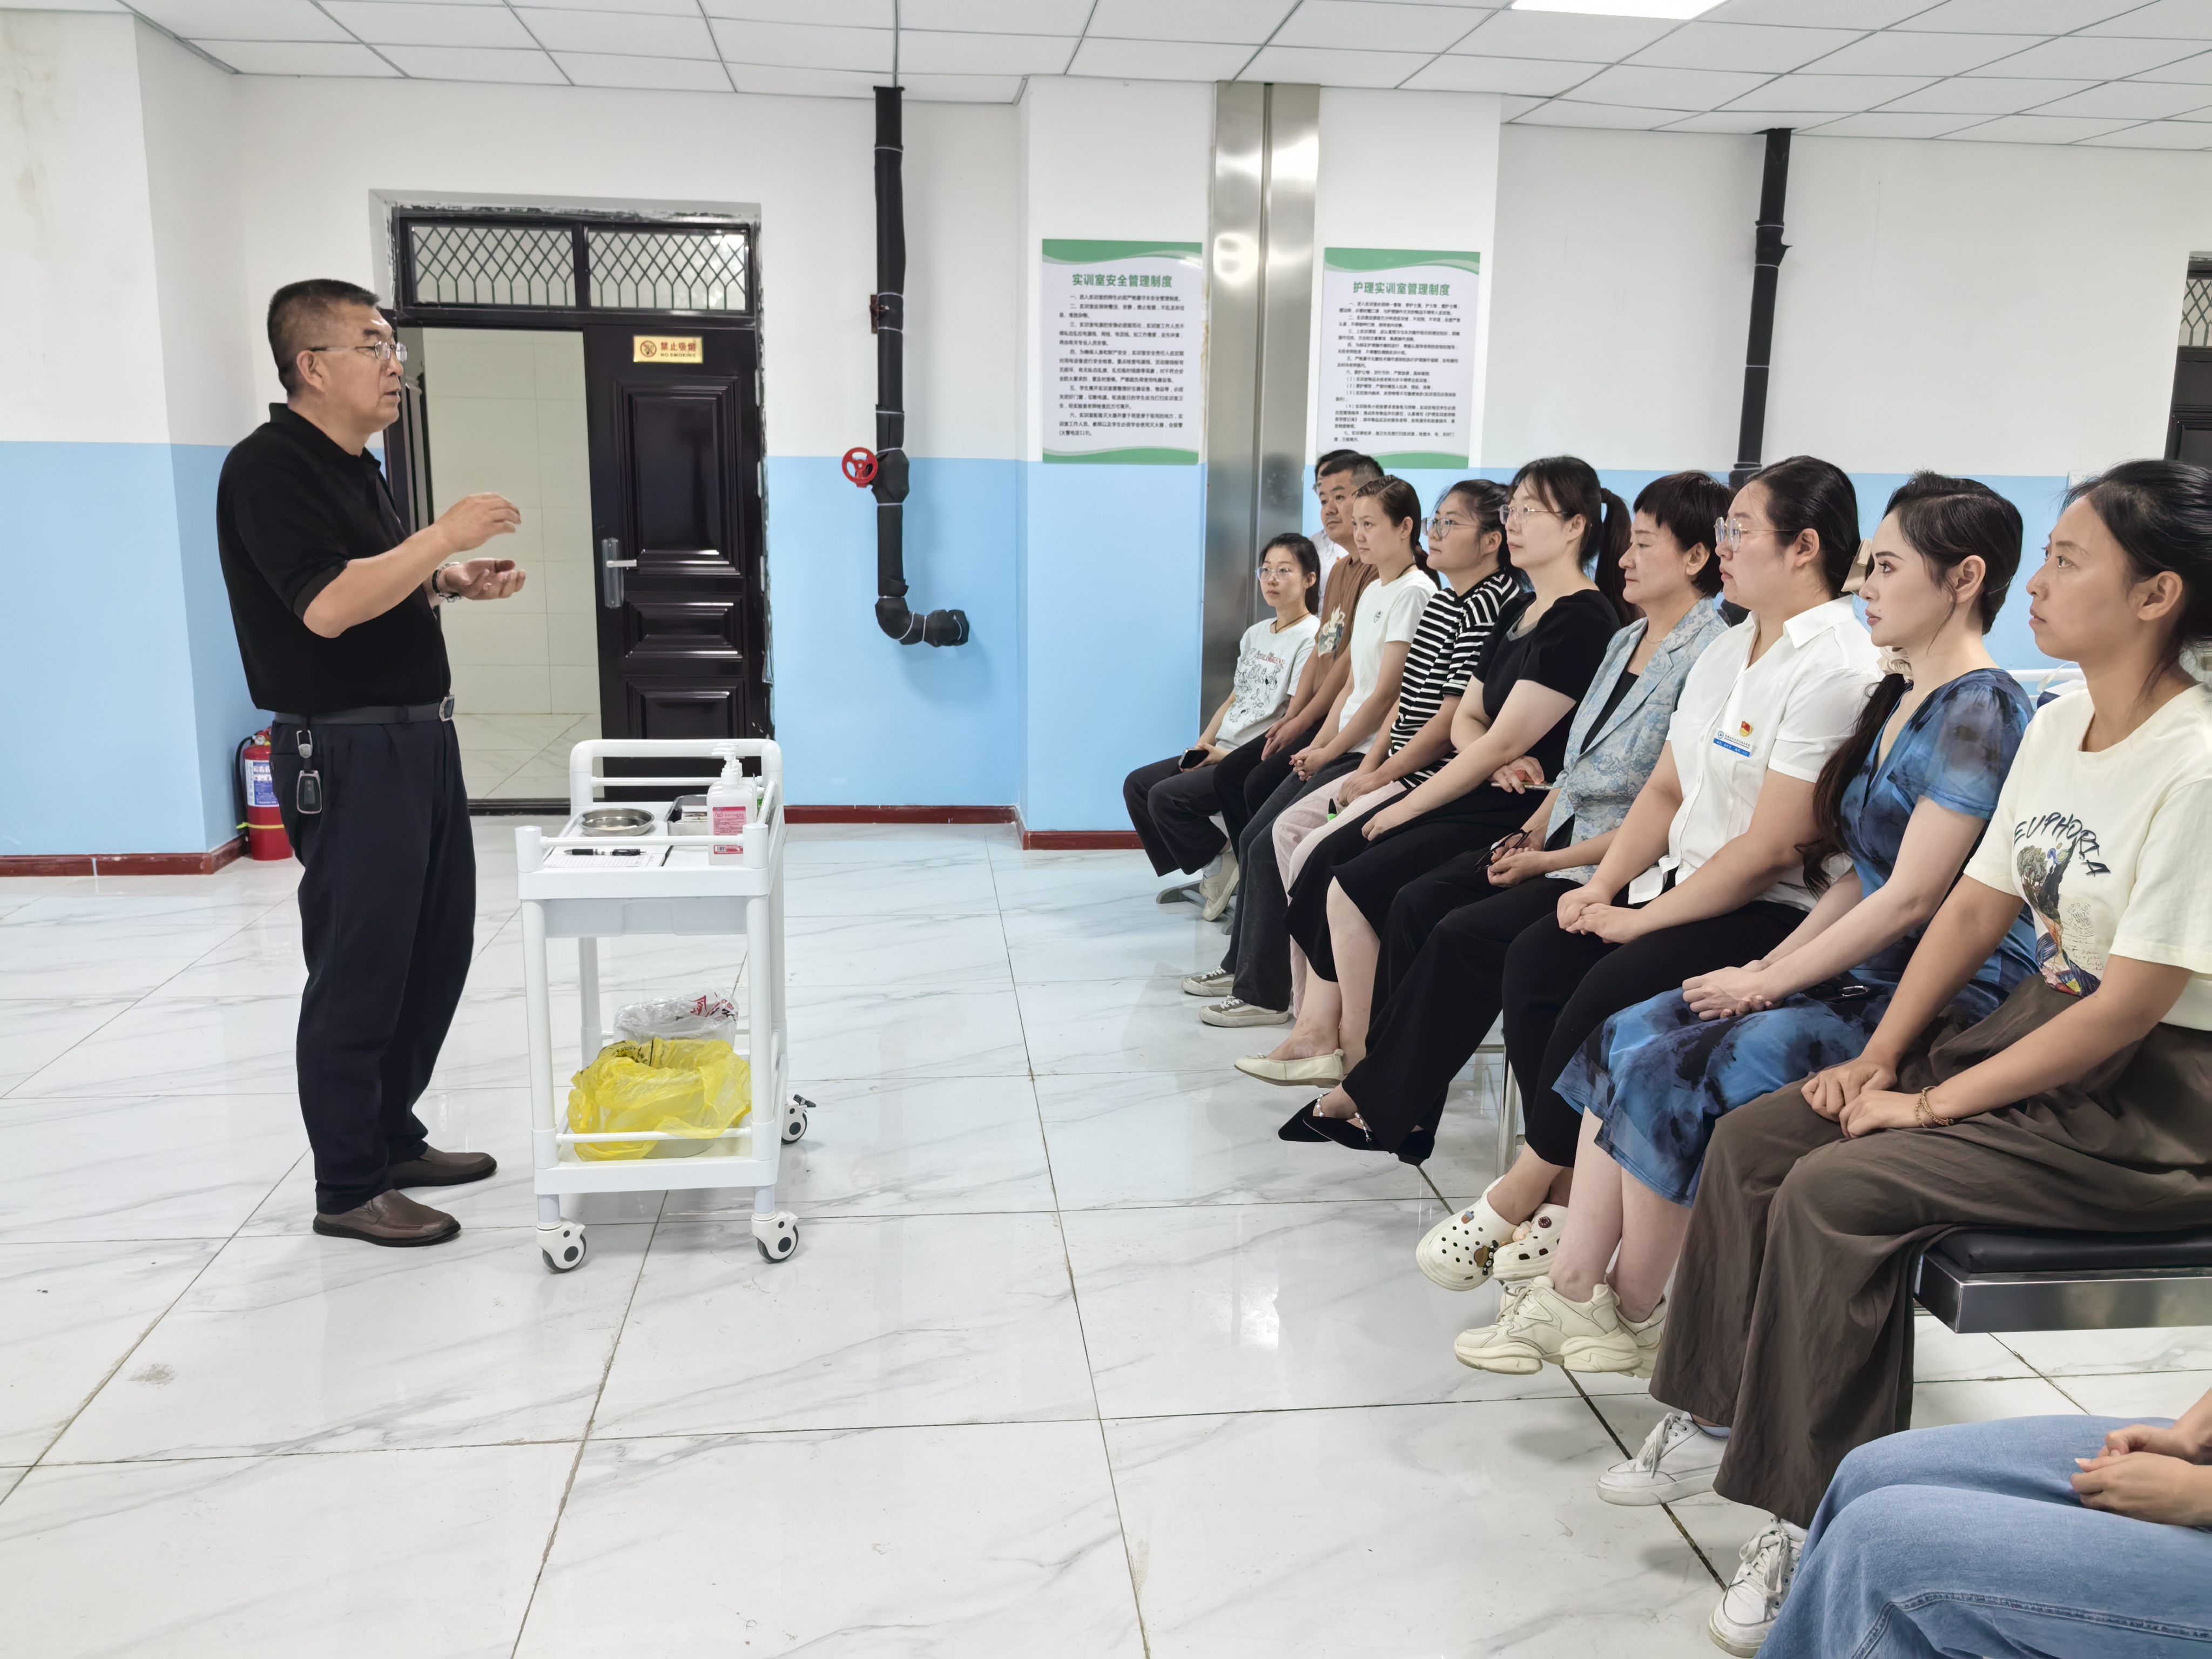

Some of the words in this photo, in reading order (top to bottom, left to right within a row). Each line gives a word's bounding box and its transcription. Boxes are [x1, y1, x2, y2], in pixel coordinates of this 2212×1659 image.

[1072, 273, 1172, 288] 实训室安全管理制度
[1353, 281, 1450, 296] 护理实训室管理制度
[660, 341, 696, 352] 禁止吸烟
